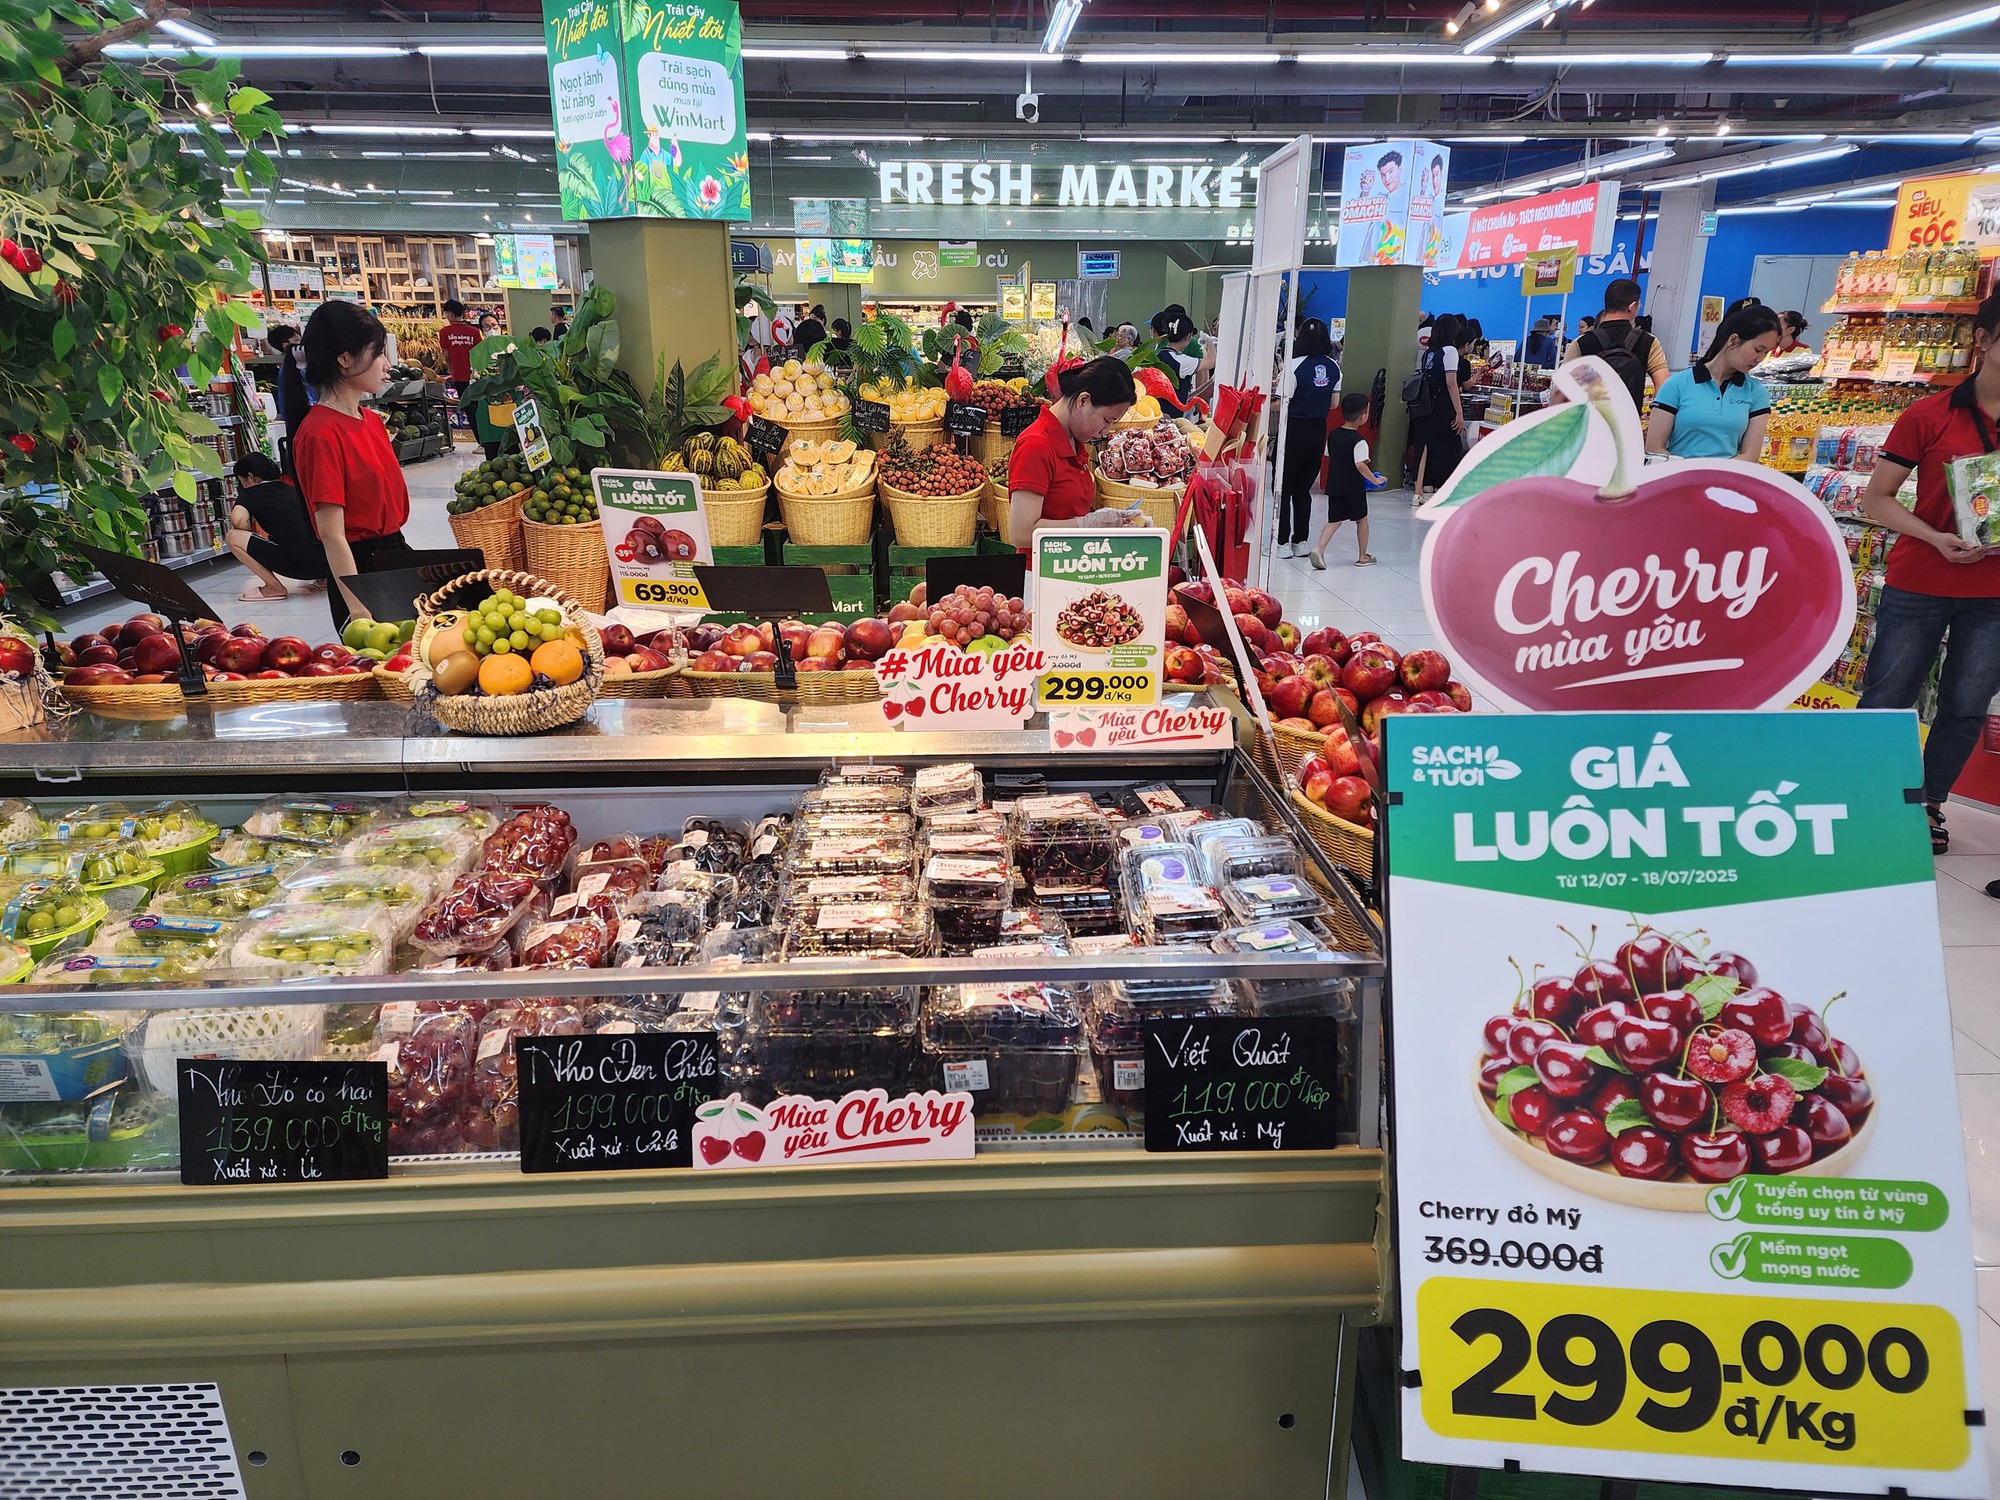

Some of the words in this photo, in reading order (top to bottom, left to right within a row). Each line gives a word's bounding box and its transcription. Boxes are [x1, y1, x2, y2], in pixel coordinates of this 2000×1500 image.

[666, 4, 685, 16] Trái
[687, 5, 705, 19] Cây
[639, 6, 697, 51] Nhiệt
[560, 74, 582, 93] Ngọt
[584, 69, 604, 86] lành
[660, 60, 683, 75] Trái
[685, 63, 712, 79] sạch
[659, 79, 688, 96] đúng
[692, 83, 716, 96] mùa
[653, 104, 726, 131] WinMart
[880, 161, 1032, 206] FRESH
[1342, 203, 1387, 220] OMACHI
[1908, 197, 1942, 219] SIÊU
[1908, 211, 1957, 247] SỐC
[772, 248, 796, 267] ÂY
[986, 248, 1009, 268] CỦ
[612, 491, 654, 505] LUÔN
[655, 490, 686, 506] TỐT
[632, 479, 656, 491] GIÁ
[1083, 538, 1112, 554] GIÁ
[1053, 555, 1105, 573] LUÔN
[1109, 551, 1148, 571] TỐT
[635, 583, 699, 602] 69.900
[1494, 546, 1780, 635] Cherry
[1515, 630, 1613, 673] mùa
[1623, 614, 1706, 666] yêu
[993, 646, 1047, 680] yêu
[930, 682, 1029, 718] Cherry
[1046, 676, 1148, 700] 299.000
[1104, 689, 1131, 702] đ/Kg
[1098, 711, 1137, 729] Mùa
[1141, 706, 1228, 739] Cherry
[1108, 726, 1138, 746] yêu
[1412, 745, 1483, 767] SẠCH
[1570, 732, 1690, 790] GIÁ
[1412, 768, 1426, 782] &
[1427, 766, 1485, 786] TƯƠI
[1454, 795, 1667, 862] LUÔN
[1683, 780, 1849, 857] TỐT
[1556, 875, 1577, 888] Từ
[1580, 873, 1627, 889] 12/07
[1641, 869, 1738, 886] 18/07/2025
[523, 1040, 594, 1084] Nho
[600, 1038, 657, 1083] Đen
[1153, 1024, 1210, 1071] Việt
[1232, 1028, 1291, 1067] Quất
[306, 1076, 328, 1103] có
[1168, 1081, 1291, 1118] 119.000
[551, 1093, 673, 1133] 199.000
[768, 1103, 829, 1131] Mùa
[835, 1097, 968, 1140] Cherry
[206, 1115, 341, 1152] 139.000
[784, 1127, 829, 1159] yêu
[1176, 1119, 1213, 1146] Xuất
[1258, 1121, 1286, 1149] Mỹ
[555, 1135, 596, 1163] Xuất
[213, 1156, 250, 1181] Xuất
[1755, 1181, 1808, 1200] Tuyển
[1812, 1185, 1855, 1202] chọn
[1859, 1187, 1880, 1201] từ
[1884, 1189, 1929, 1206] vùng
[1419, 1201, 1500, 1226] Cherry
[1508, 1203, 1538, 1224] đỏ
[1546, 1207, 1582, 1230] Mỹ
[1756, 1201, 1804, 1220] trồng
[1809, 1208, 1830, 1221] uy
[1834, 1206, 1859, 1220] tín
[1863, 1205, 1876, 1221] ở
[1879, 1208, 1906, 1224] Mỹ
[1423, 1235, 1604, 1274] 369.000đ
[1760, 1239, 1802, 1256] Mềm
[1806, 1245, 1848, 1261] ngọt
[1762, 1262, 1812, 1278] mọng
[1816, 1264, 1861, 1278] nước
[1450, 1307, 1930, 1434] 299.000
[1723, 1395, 1856, 1452] đ/Kg
